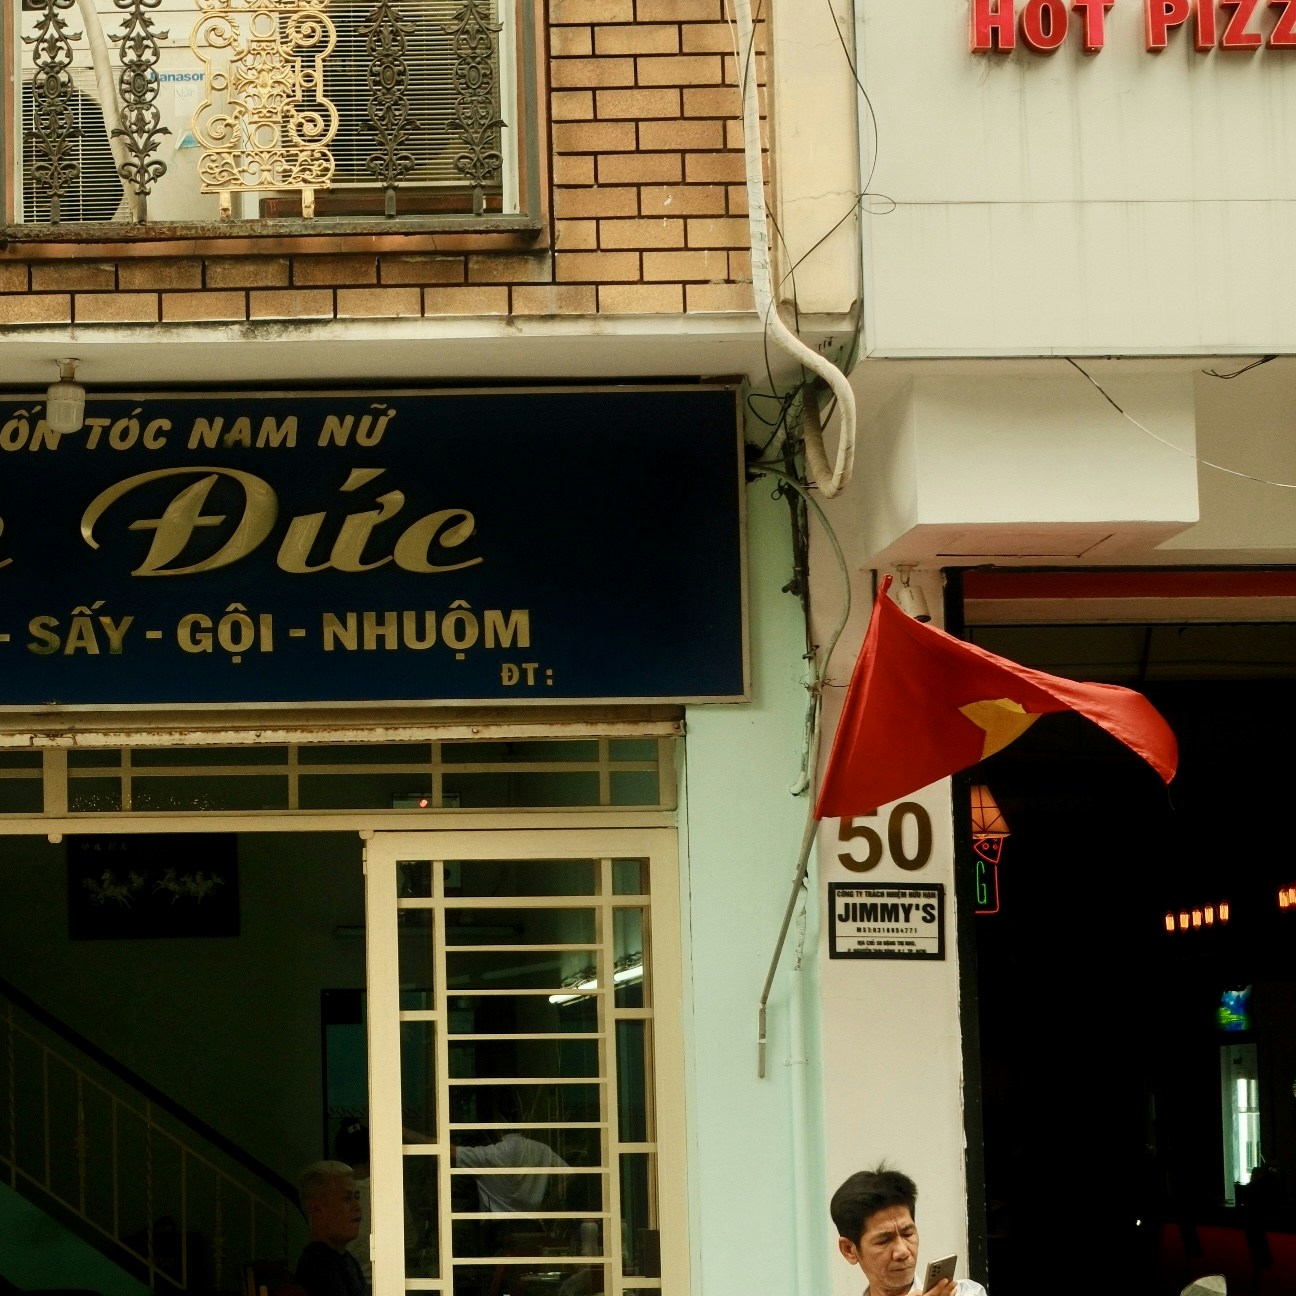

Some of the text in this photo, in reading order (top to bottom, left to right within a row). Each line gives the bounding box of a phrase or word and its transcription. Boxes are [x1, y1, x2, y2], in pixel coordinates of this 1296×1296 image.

[84, 407, 172, 451] TÓC
[187, 415, 298, 449] NAM
[317, 403, 397, 447] NỮ
[80, 466, 484, 577] Đức
[26, 600, 135, 656] SẤY
[176, 602, 273, 664] GỘI
[322, 599, 531, 660] NHUỘM
[837, 802, 932, 872] 50
[837, 902, 936, 923] JIMMY'S
